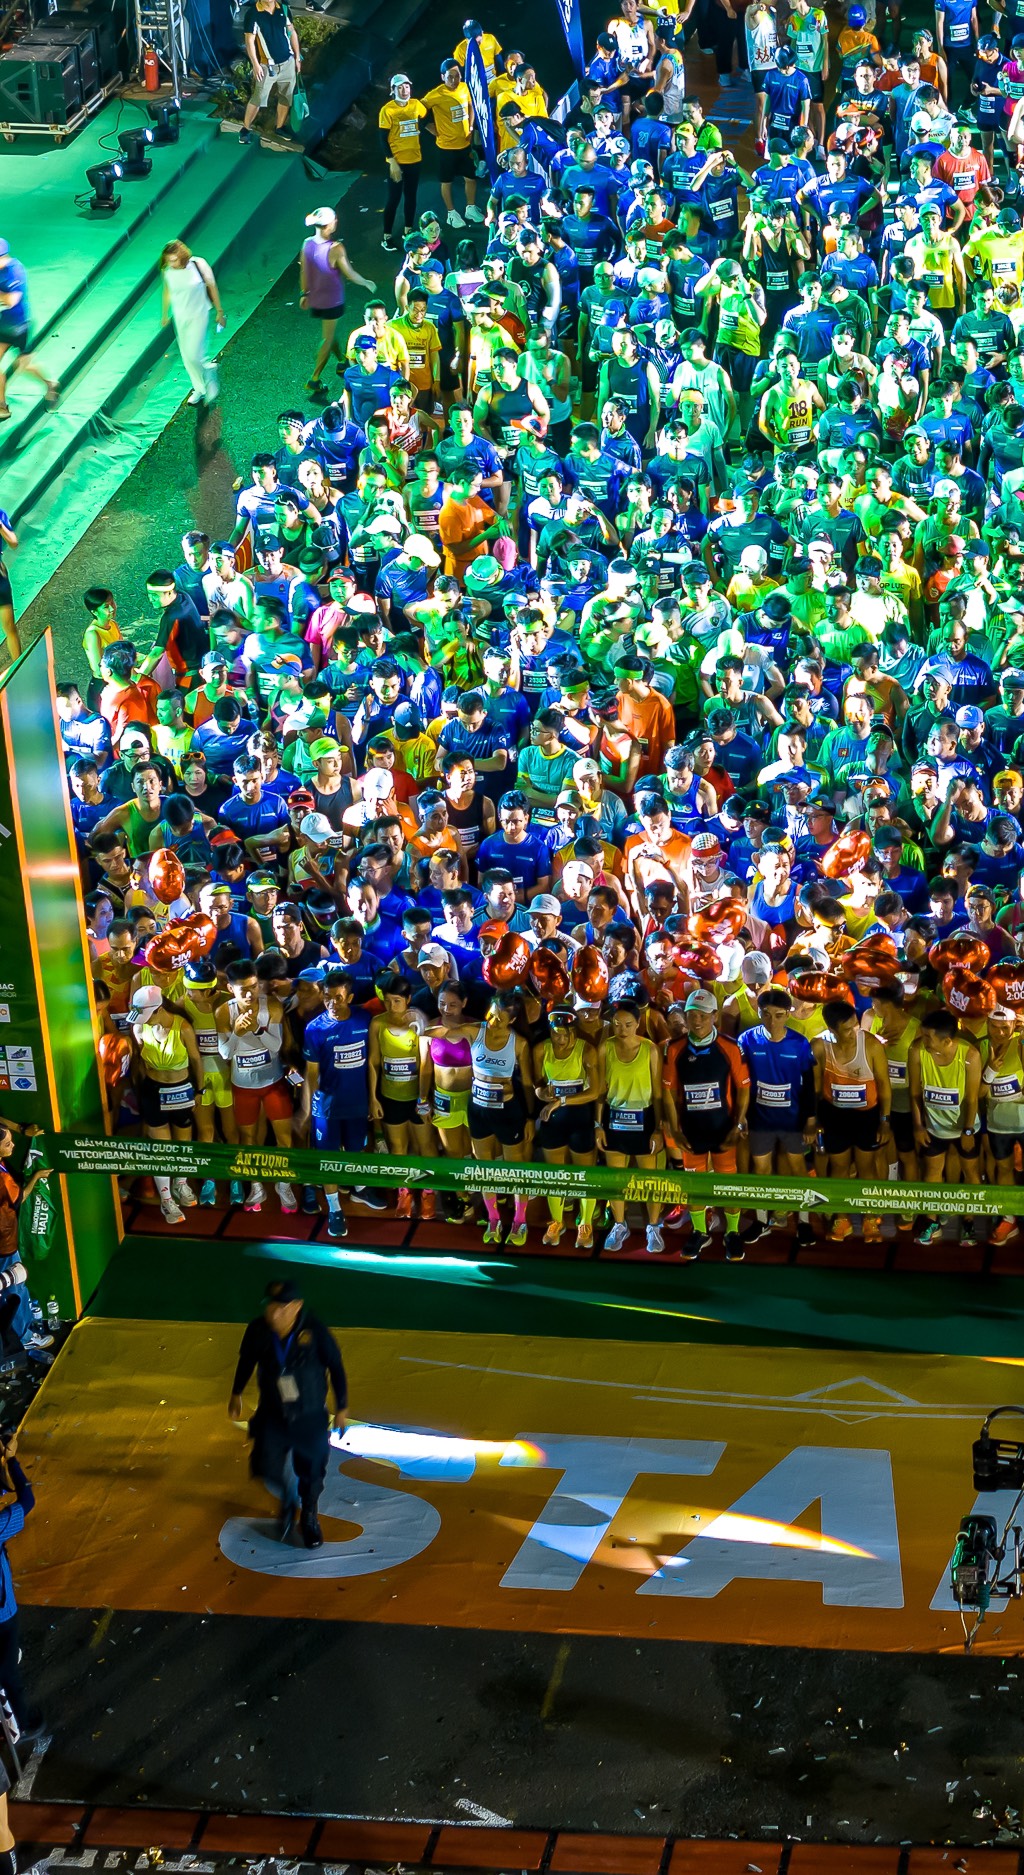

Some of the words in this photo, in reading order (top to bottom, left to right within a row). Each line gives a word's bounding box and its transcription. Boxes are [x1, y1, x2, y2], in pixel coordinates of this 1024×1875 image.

[789, 418, 809, 428] RUN
[485, 1058, 506, 1067] asics
[993, 1083, 1013, 1094] PACER
[167, 1092, 188, 1102] PACER
[930, 1092, 952, 1102] PACER
[615, 1112, 636, 1121] PACER
[344, 1163, 378, 1174] GIANG
[379, 1166, 409, 1177] 2023
[487, 1167, 542, 1179] MARATHON
[886, 1187, 940, 1199] MARATHON
[922, 1201, 965, 1213] MEKONG
